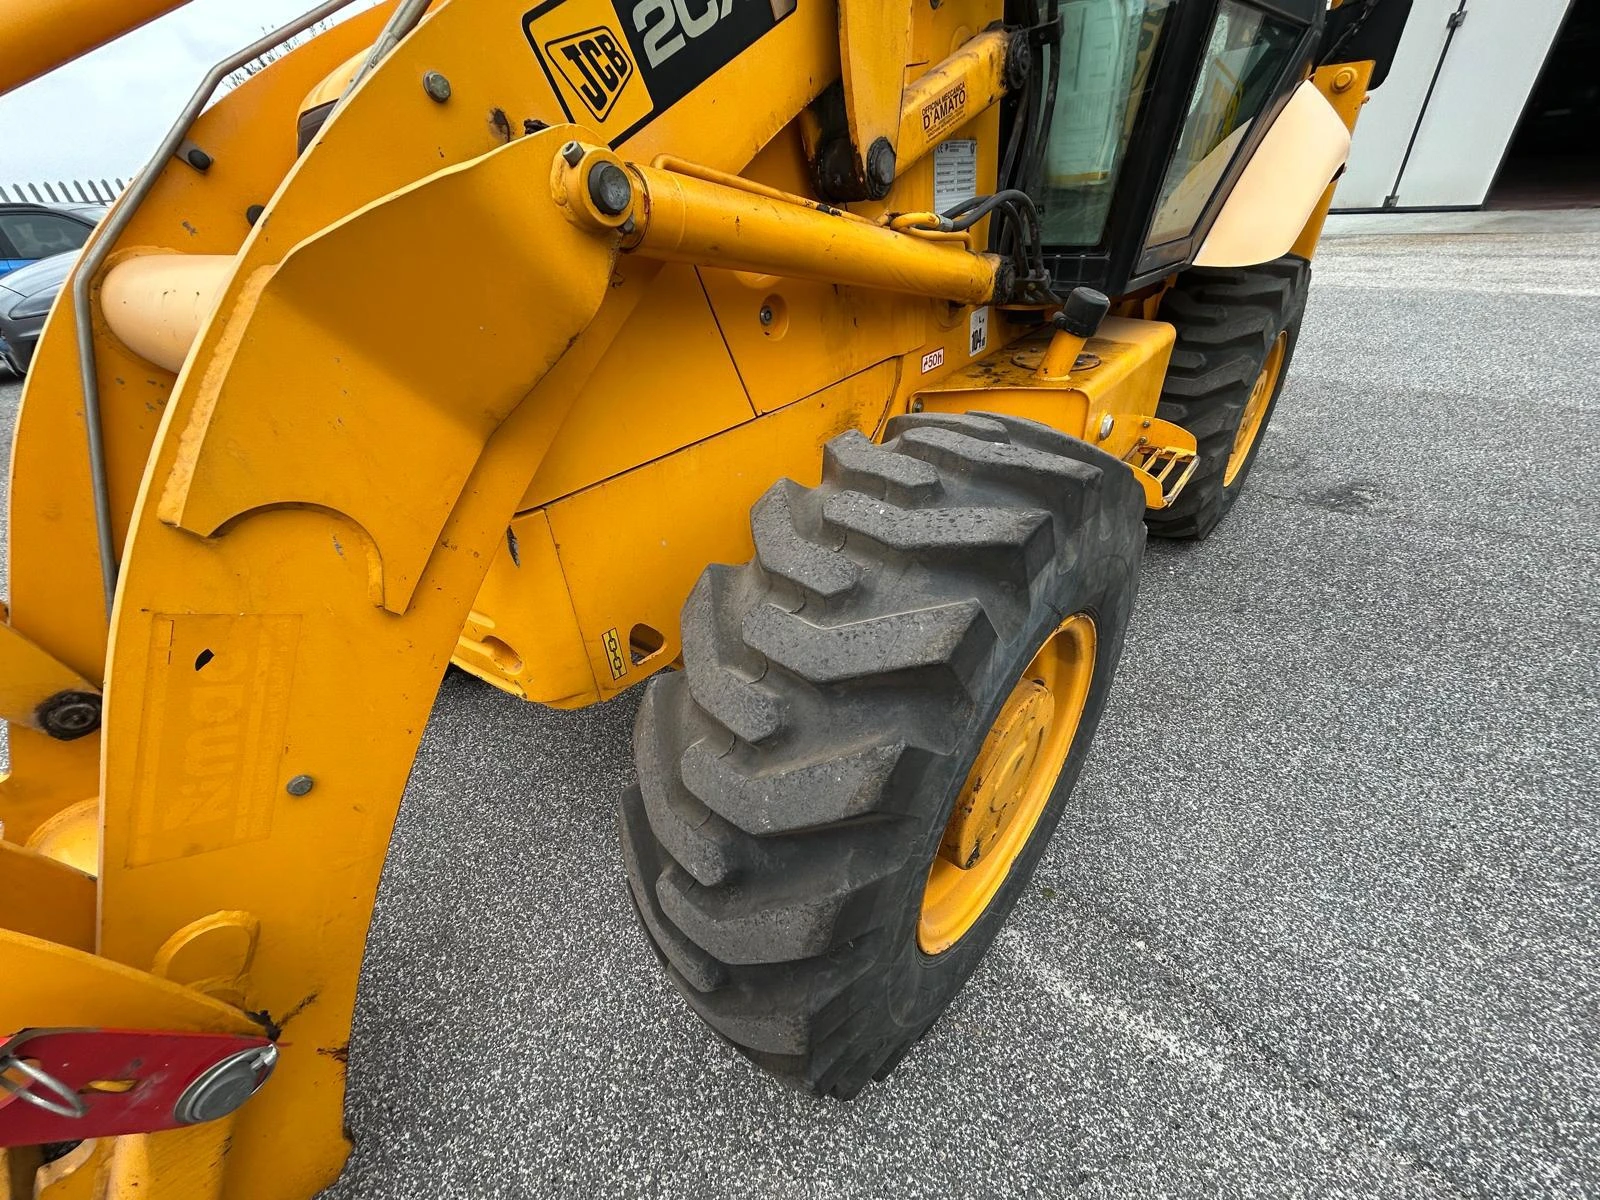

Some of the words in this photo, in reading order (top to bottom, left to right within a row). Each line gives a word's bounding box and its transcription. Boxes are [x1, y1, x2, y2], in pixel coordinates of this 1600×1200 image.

[632, 0, 749, 68] 2C
[561, 34, 627, 111] JCB
[922, 101, 941, 116] OFFICINA
[942, 81, 965, 103] MECCANICA
[923, 90, 966, 129] D'AMATO
